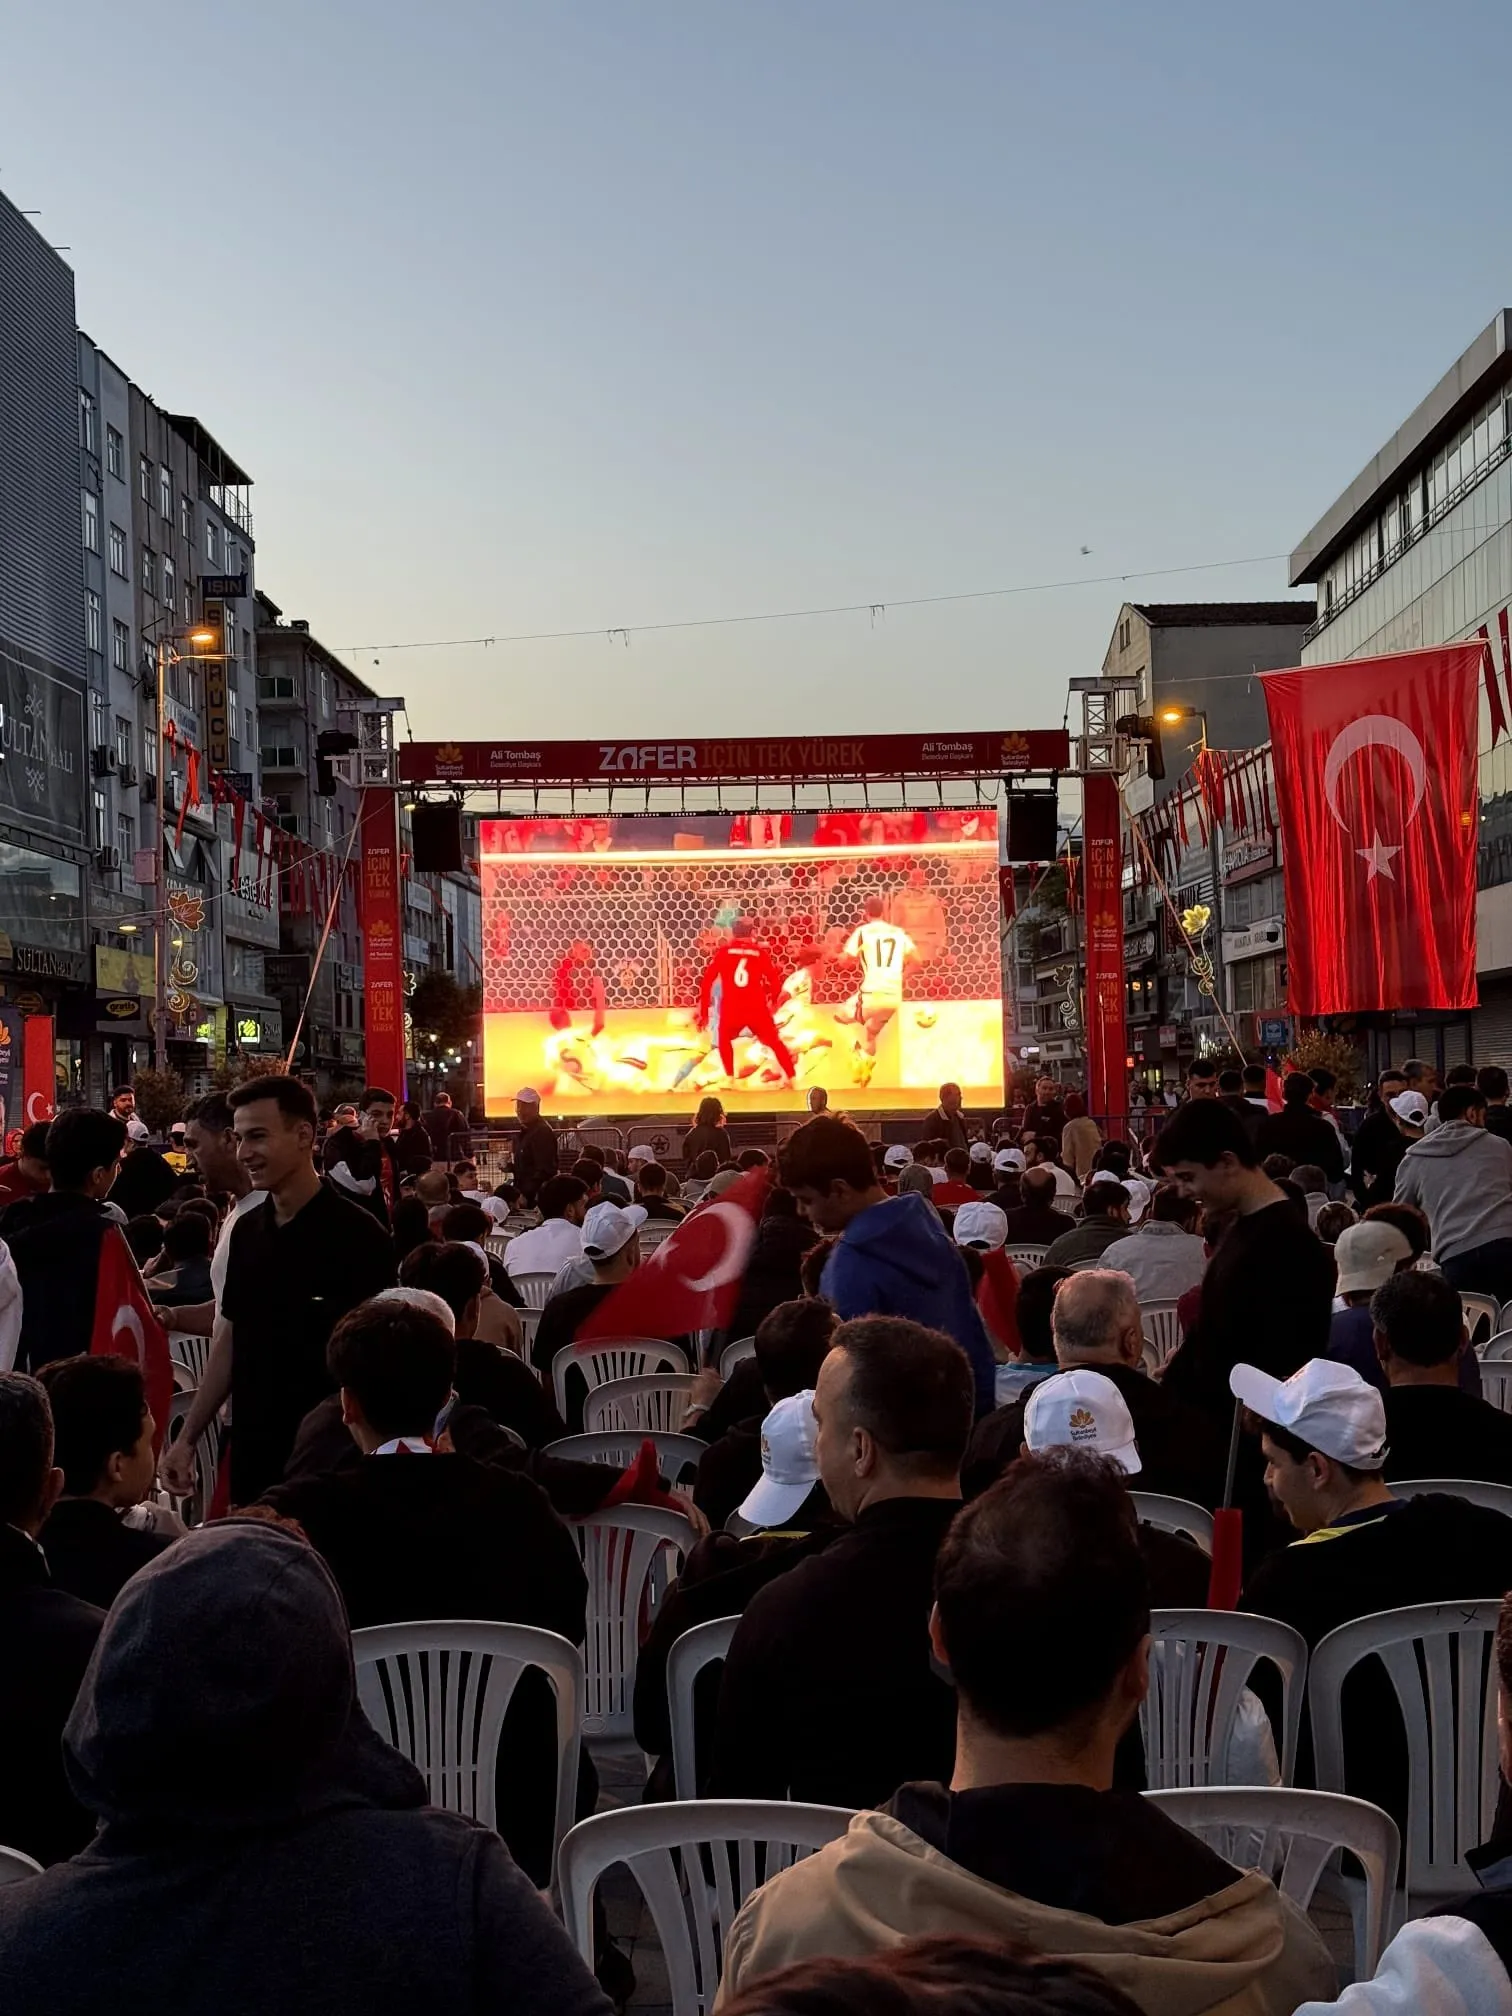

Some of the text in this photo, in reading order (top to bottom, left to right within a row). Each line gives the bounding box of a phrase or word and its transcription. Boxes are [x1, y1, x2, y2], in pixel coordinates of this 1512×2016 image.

[922, 742, 974, 753] Ali Tombaş
[490, 750, 541, 761] Ali Tombaş
[599, 738, 865, 773] ZAFER İÇİN TEK YÜREK
[368, 873, 390, 887] TEK
[876, 938, 896, 968] 17
[17, 947, 57, 976] SULTAN
[734, 957, 749, 988] 6
[109, 1000, 136, 1013] gratis
[372, 1007, 393, 1020] TEK
